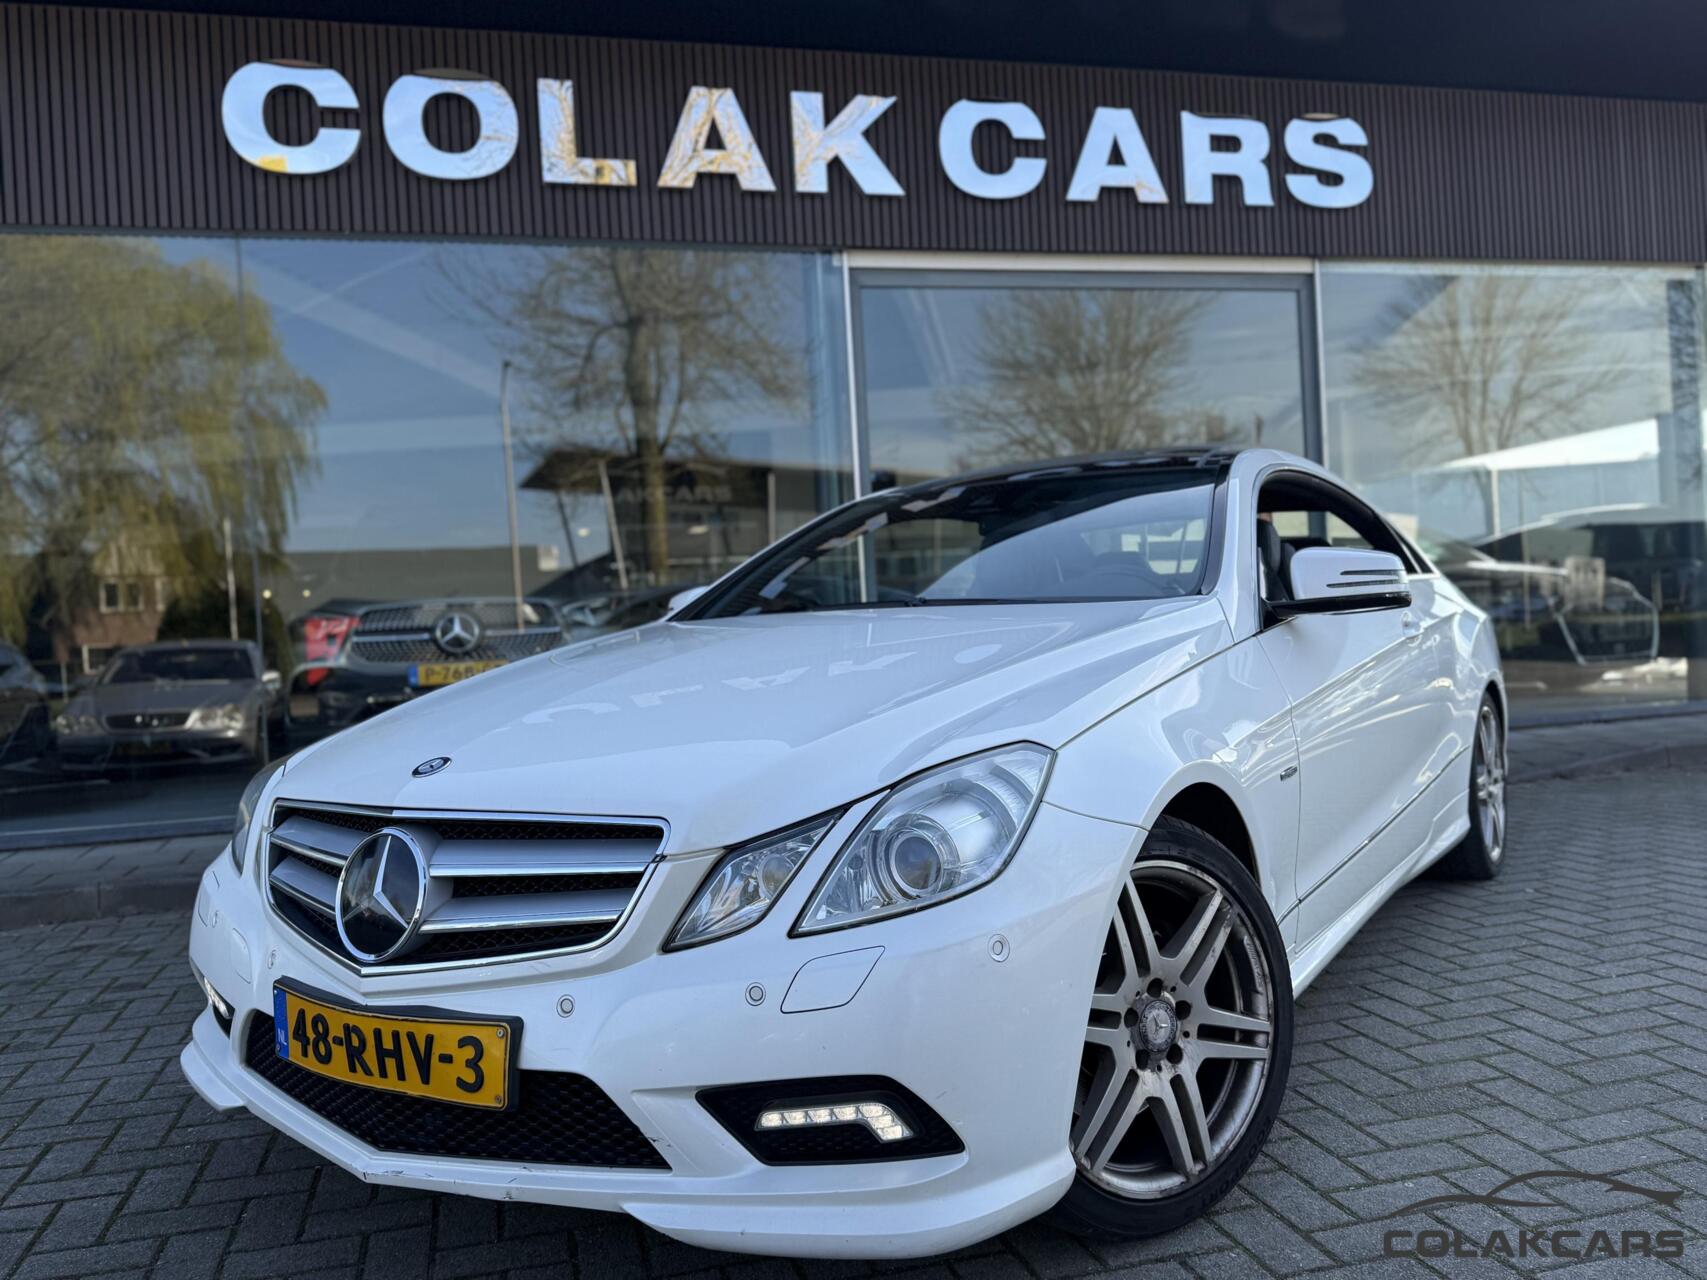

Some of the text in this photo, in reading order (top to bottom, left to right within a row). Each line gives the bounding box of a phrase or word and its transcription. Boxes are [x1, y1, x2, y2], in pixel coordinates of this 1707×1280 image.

[221, 60, 1375, 209] COLAK CARS
[292, 1008, 485, 1094] 48-RHV-3
